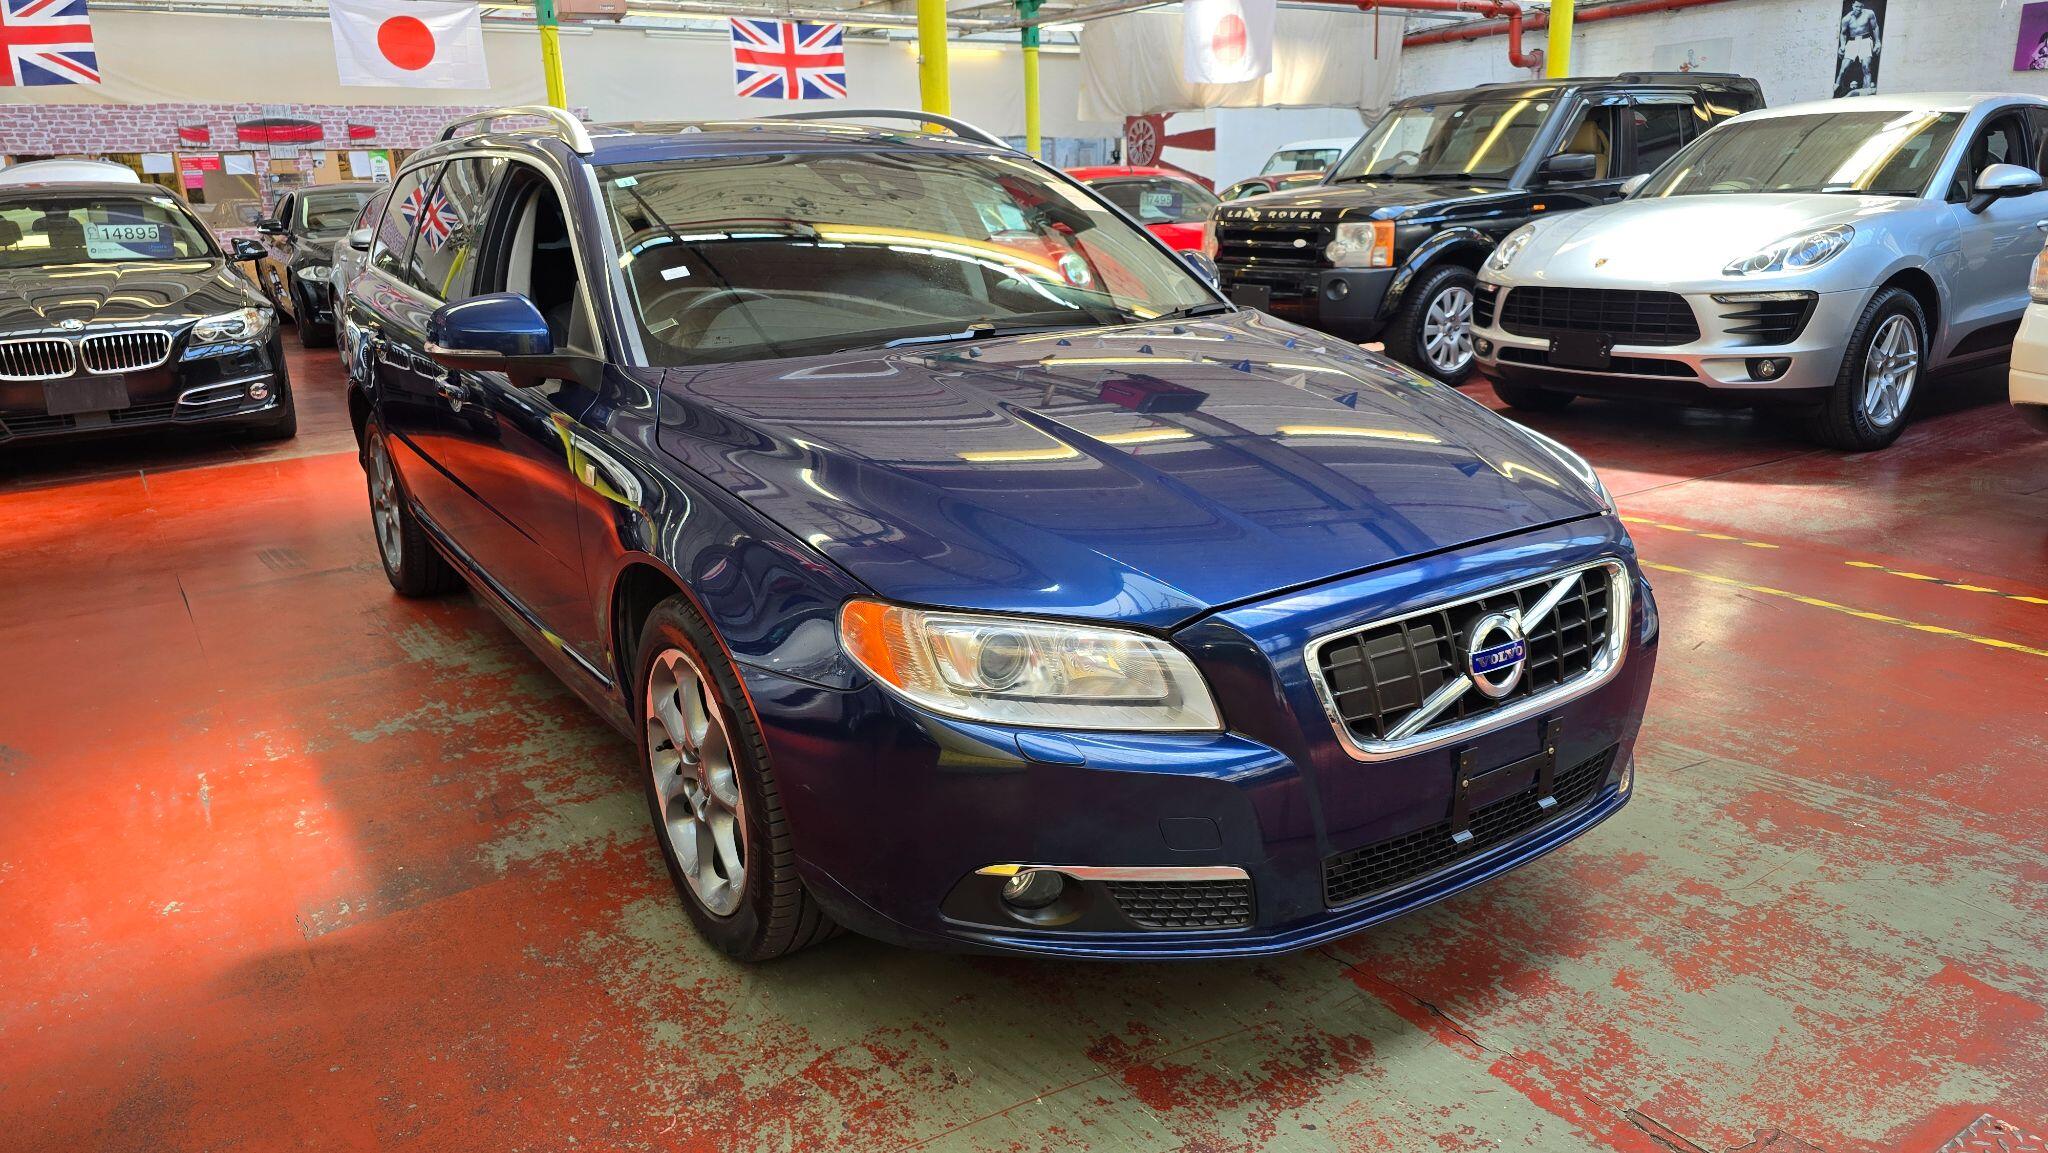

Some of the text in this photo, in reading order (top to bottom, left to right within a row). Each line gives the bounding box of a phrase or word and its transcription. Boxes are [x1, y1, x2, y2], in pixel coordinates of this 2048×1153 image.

[1227, 209, 1321, 219] LAND ROVER
[1476, 645, 1523, 667] VOLVO
